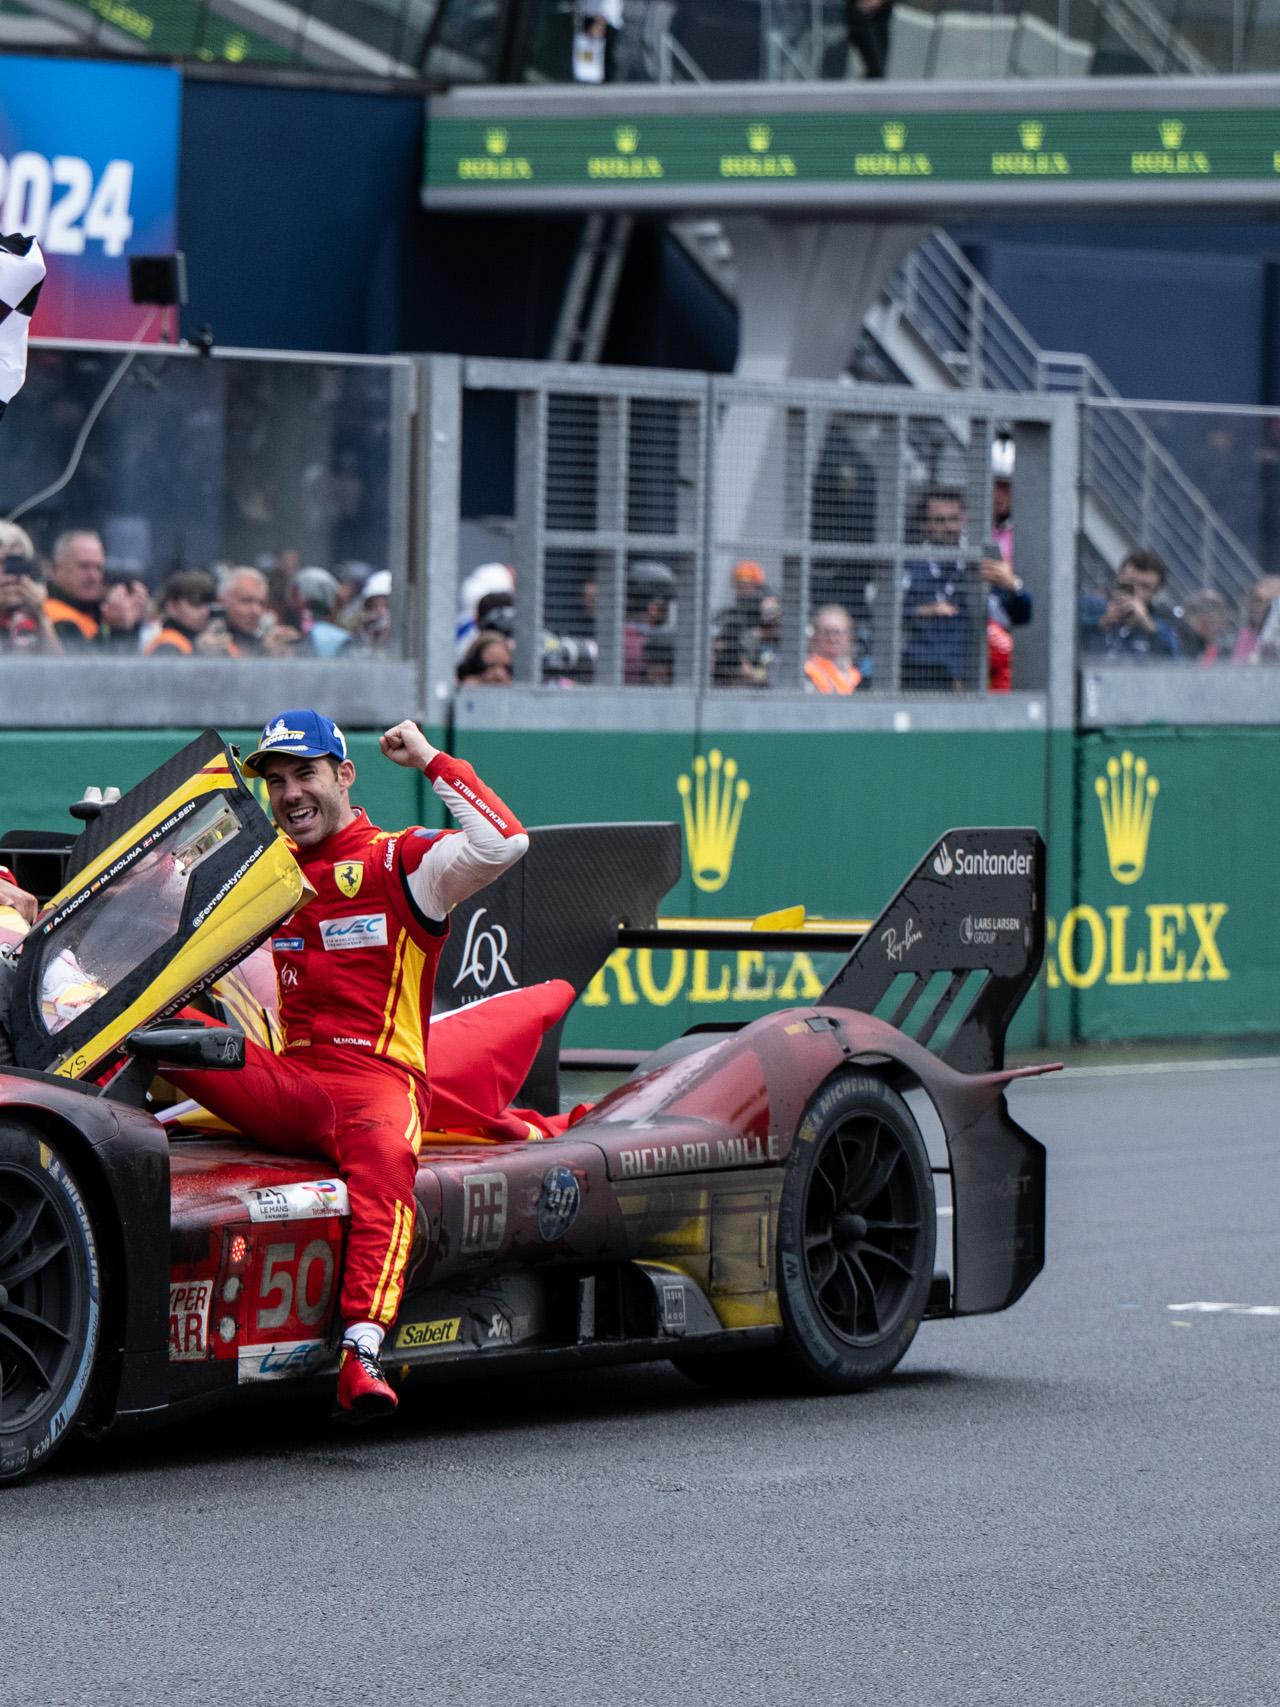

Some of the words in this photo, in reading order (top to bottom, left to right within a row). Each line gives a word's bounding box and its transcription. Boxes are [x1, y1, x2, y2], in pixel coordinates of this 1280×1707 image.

[454, 779, 477, 797] MILLE
[475, 798, 508, 830] RICHARD
[954, 849, 1033, 875] Santander
[193, 845, 264, 928] @FerrariHypercar
[325, 917, 384, 937] WEC
[973, 931, 996, 944] GROUP
[974, 918, 992, 930] LARS
[993, 918, 1020, 931] LARSEN
[881, 918, 923, 961] Ray-Ban
[620, 1142, 710, 1176] RICHARD
[717, 1135, 780, 1165] MILLE
[62, 1175, 99, 1289] MICHELIN
[257, 1239, 335, 1330] 50
[403, 1321, 453, 1345] Sabelt
